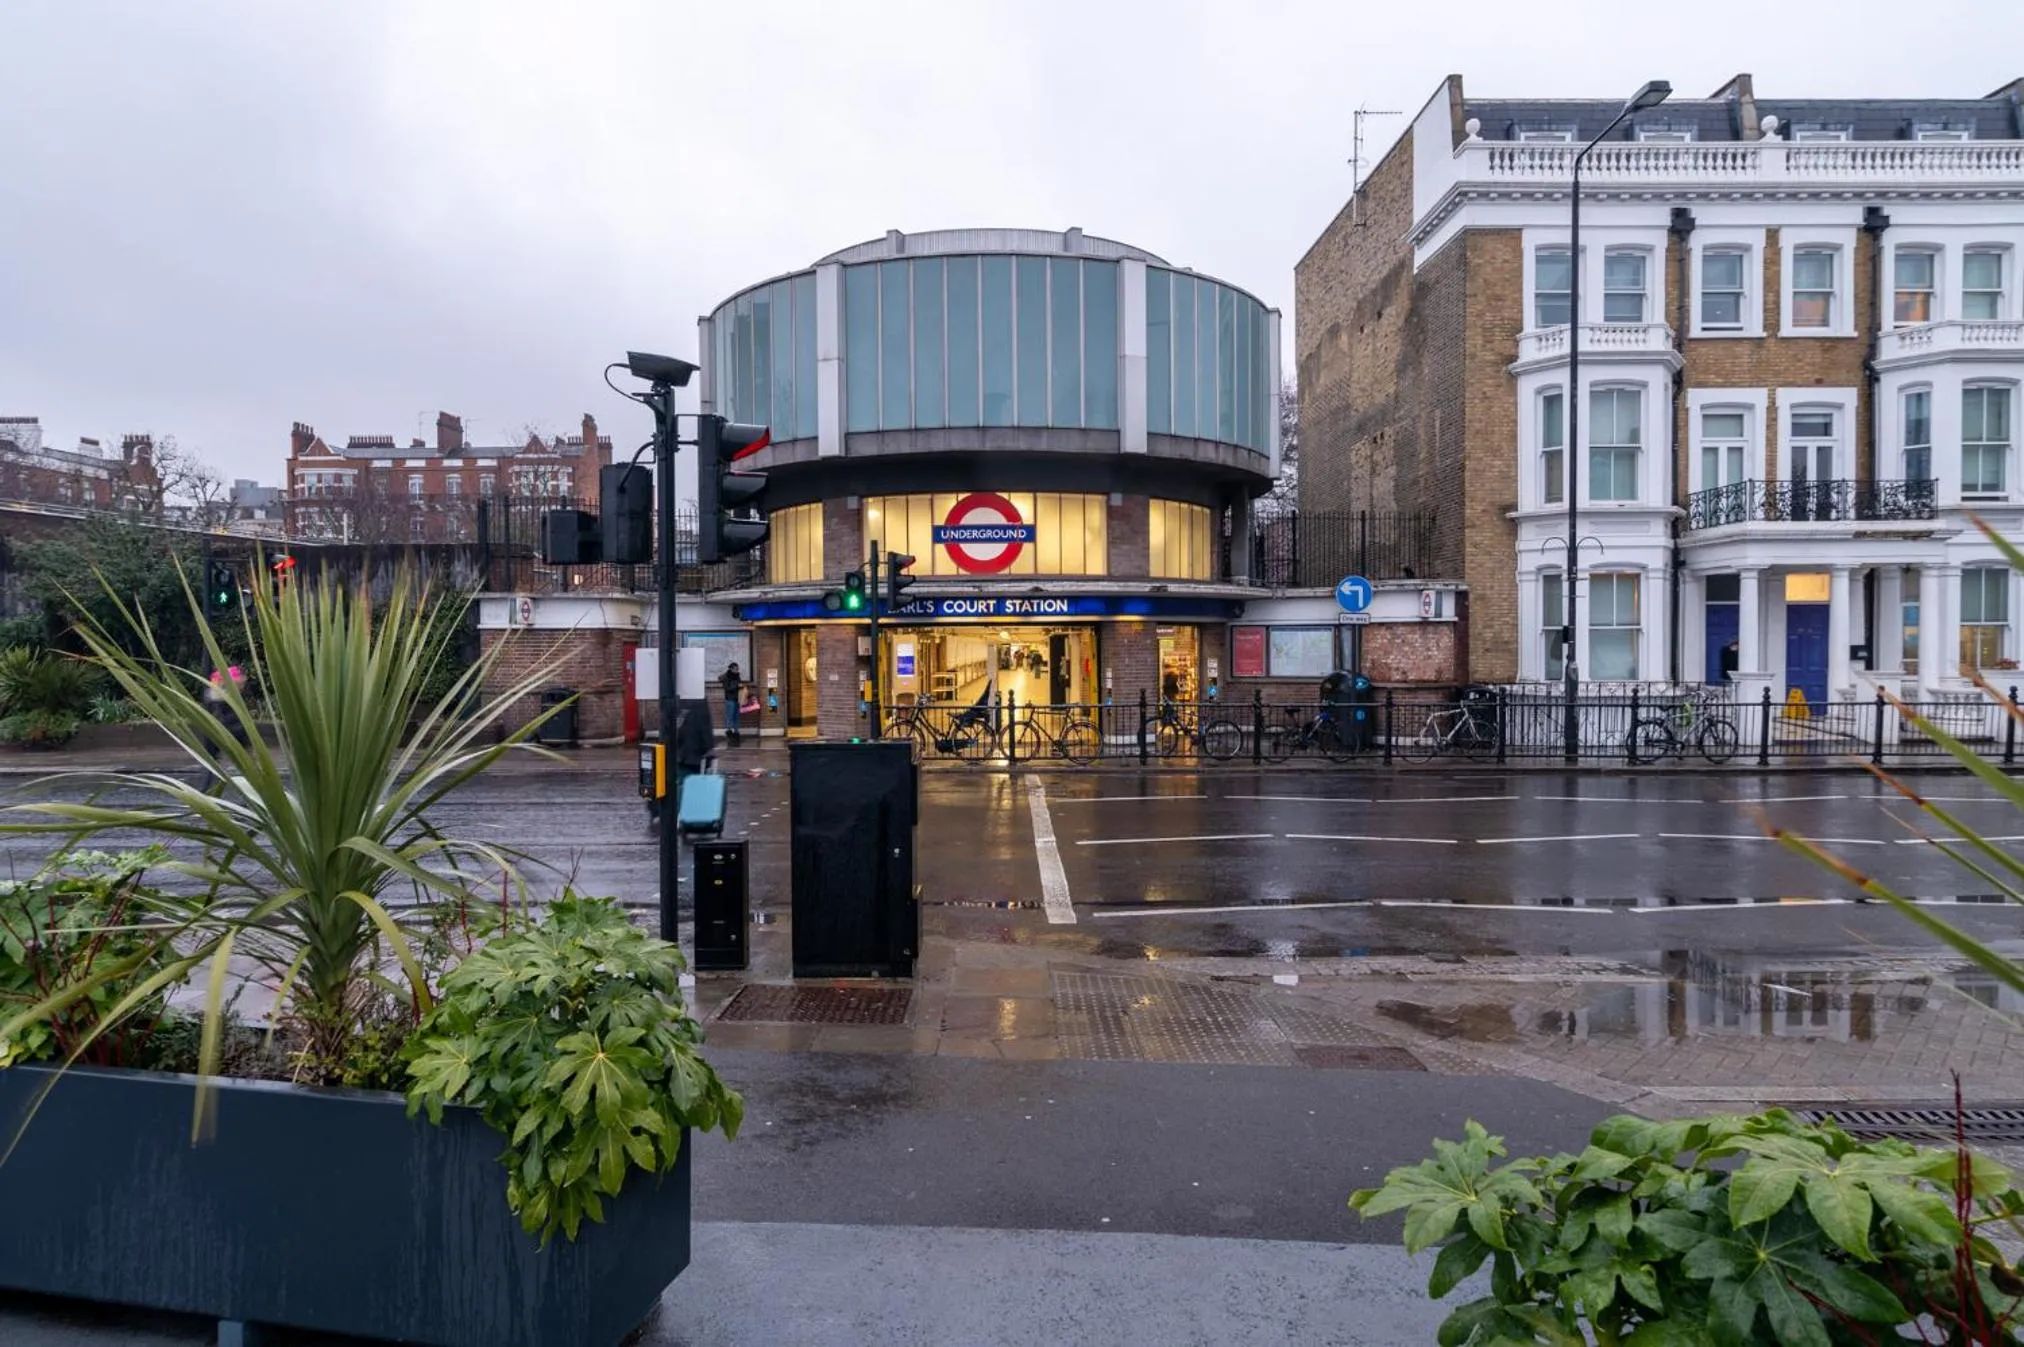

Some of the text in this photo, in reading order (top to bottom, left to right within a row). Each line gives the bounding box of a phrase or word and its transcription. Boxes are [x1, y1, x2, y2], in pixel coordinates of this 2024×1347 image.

[940, 528, 1027, 539] UNDERGROUND
[888, 599, 1068, 613] RL'S COURT STATION
